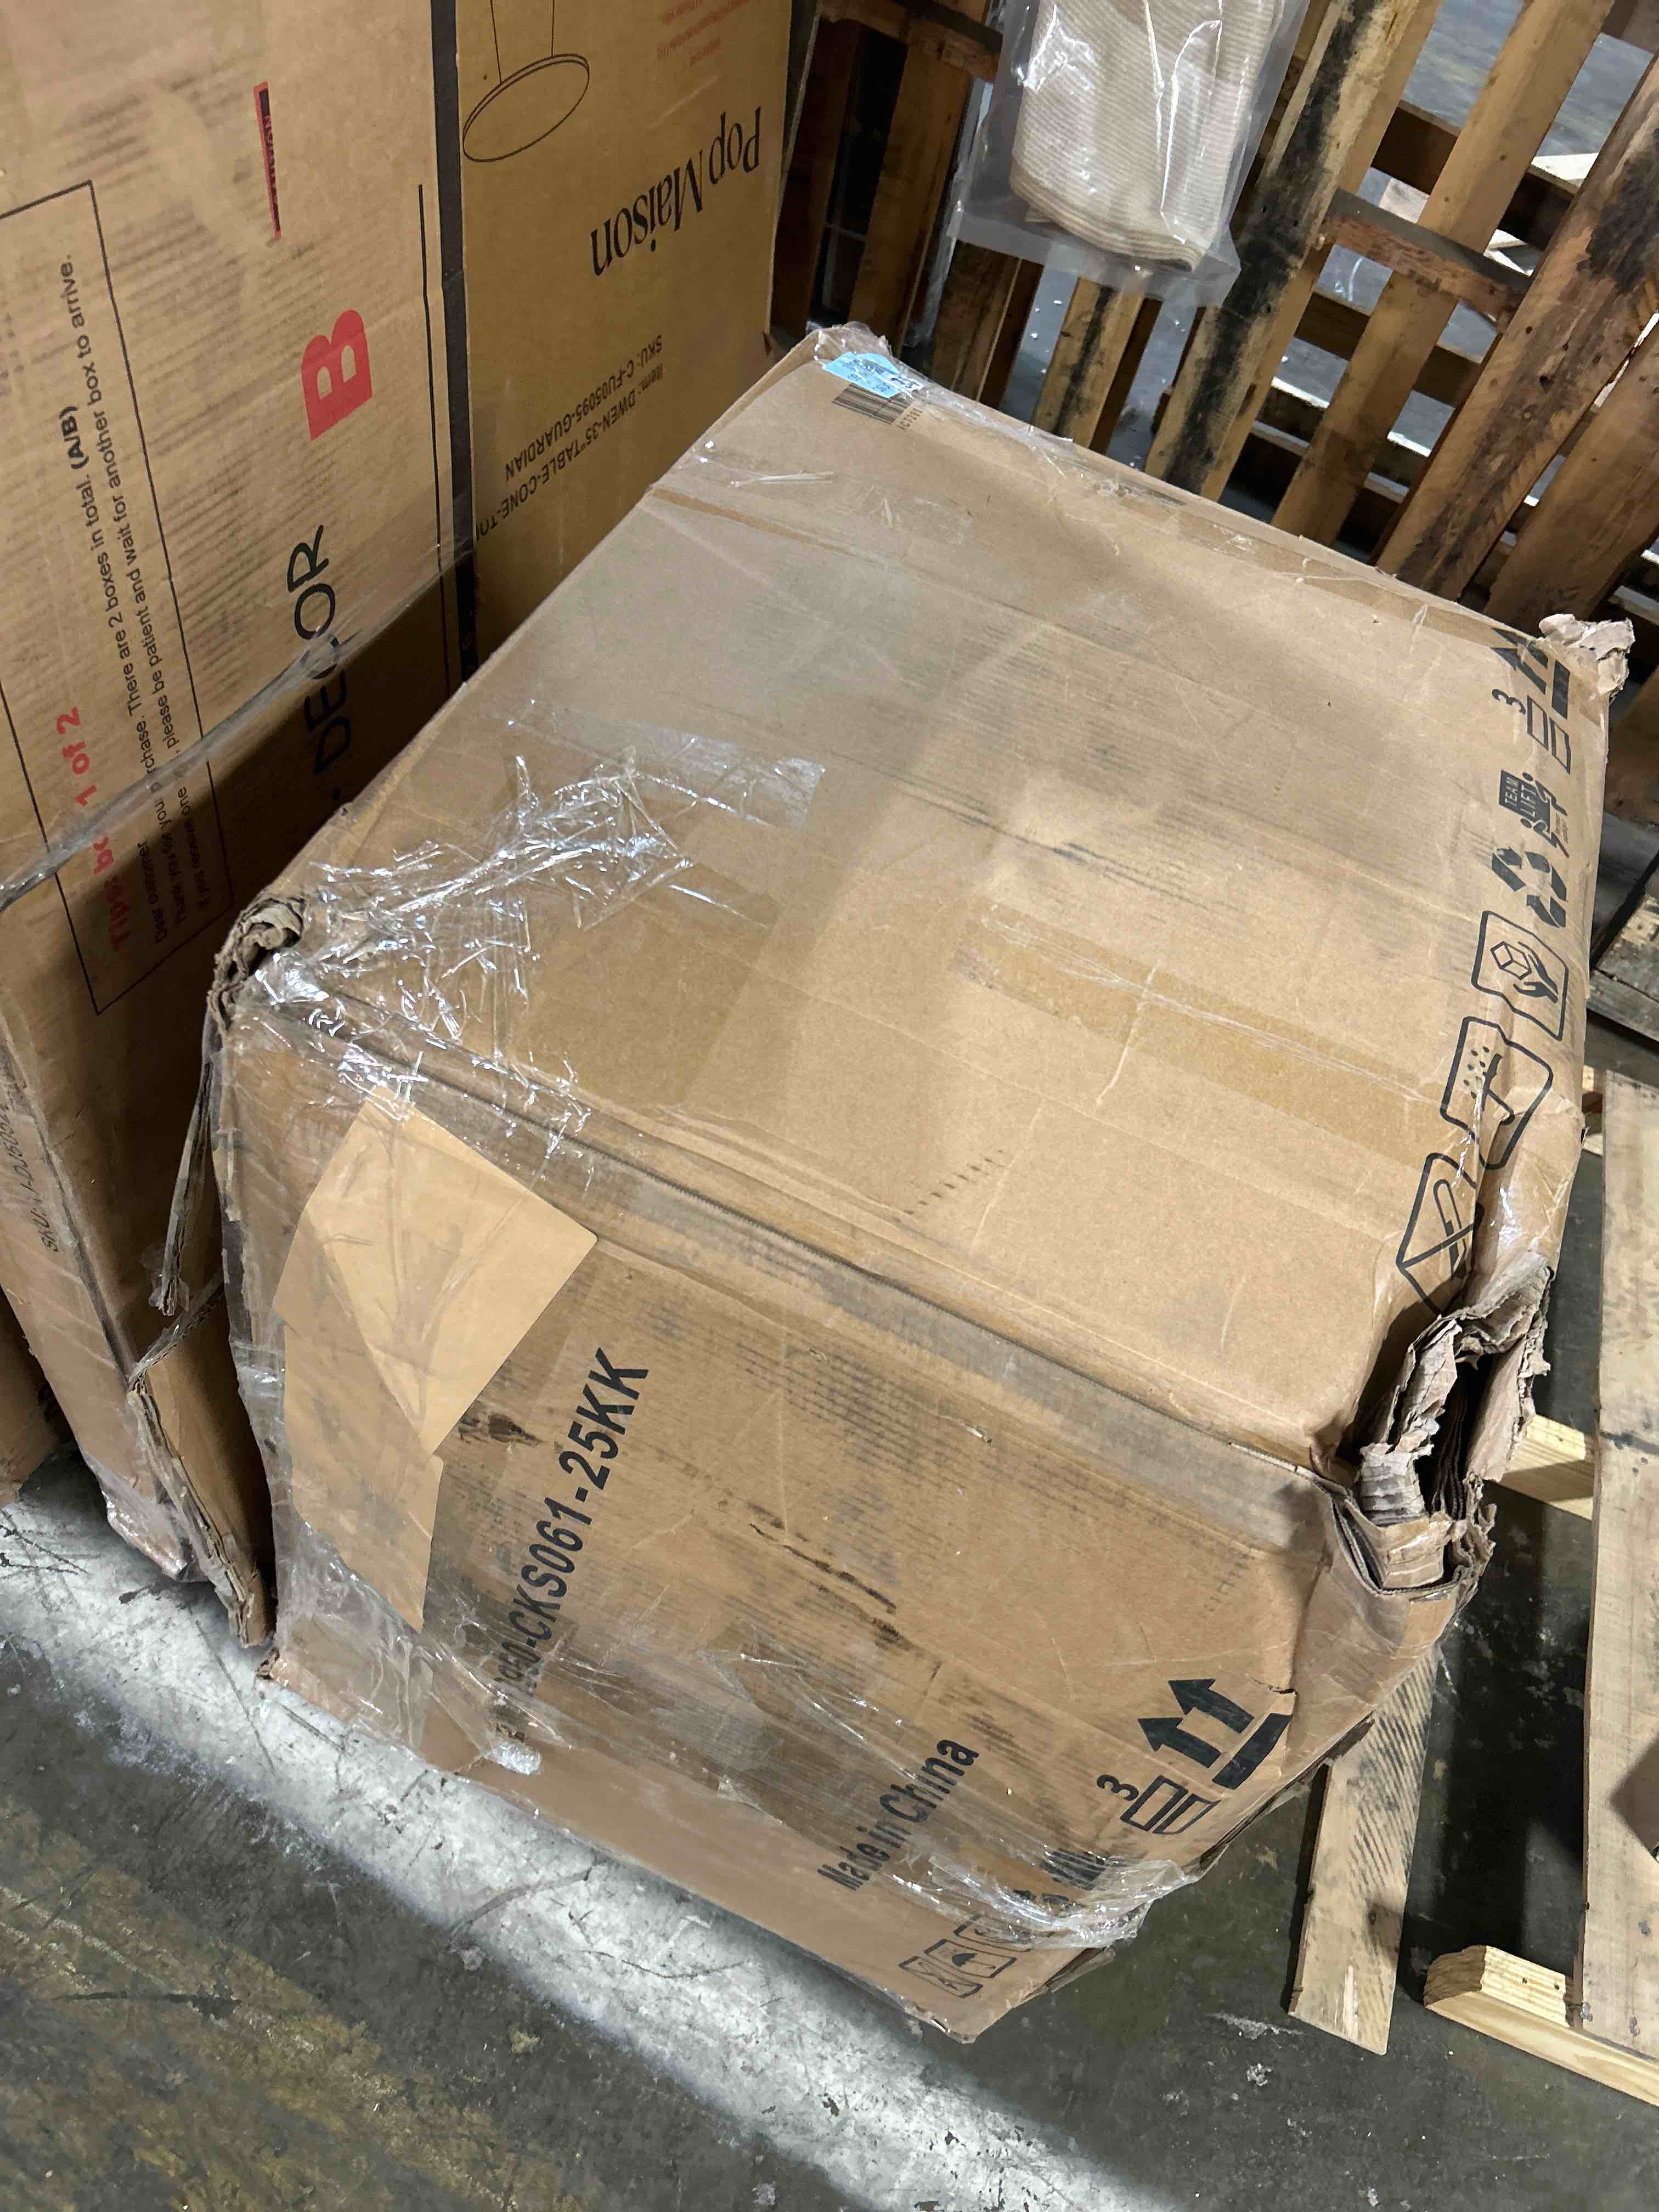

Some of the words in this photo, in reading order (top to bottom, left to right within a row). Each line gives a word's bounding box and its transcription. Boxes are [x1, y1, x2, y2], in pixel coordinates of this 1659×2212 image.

[709, 105, 761, 184] Pop
[591, 149, 703, 275] Maison
[59, 254, 85, 329] arrive.
[76, 334, 92, 359] to
[83, 360, 103, 406] box
[301, 309, 373, 441] B
[59, 405, 89, 470] (A/B)
[93, 410, 121, 489] another
[111, 494, 128, 521] for
[92, 527, 104, 551] in
[115, 521, 138, 567] wait
[97, 551, 119, 613] boxes
[126, 568, 146, 605] and
[109, 612, 123, 628] 2
[136, 605, 163, 668] patient
[115, 628, 131, 659] are
[123, 662, 142, 716] There
[152, 669, 165, 695] be
[1492, 689, 1526, 715] 3
[57, 707, 81, 735] 2
[157, 694, 179, 749] please
[62, 741, 90, 775] of
[75, 785, 97, 807] 1
[177, 787, 191, 816] one
[1504, 776, 1519, 806] TEAM
[1520, 783, 1537, 817] LIFT
[879, 1739, 980, 1823] China
[1097, 1774, 1139, 1802] 3
